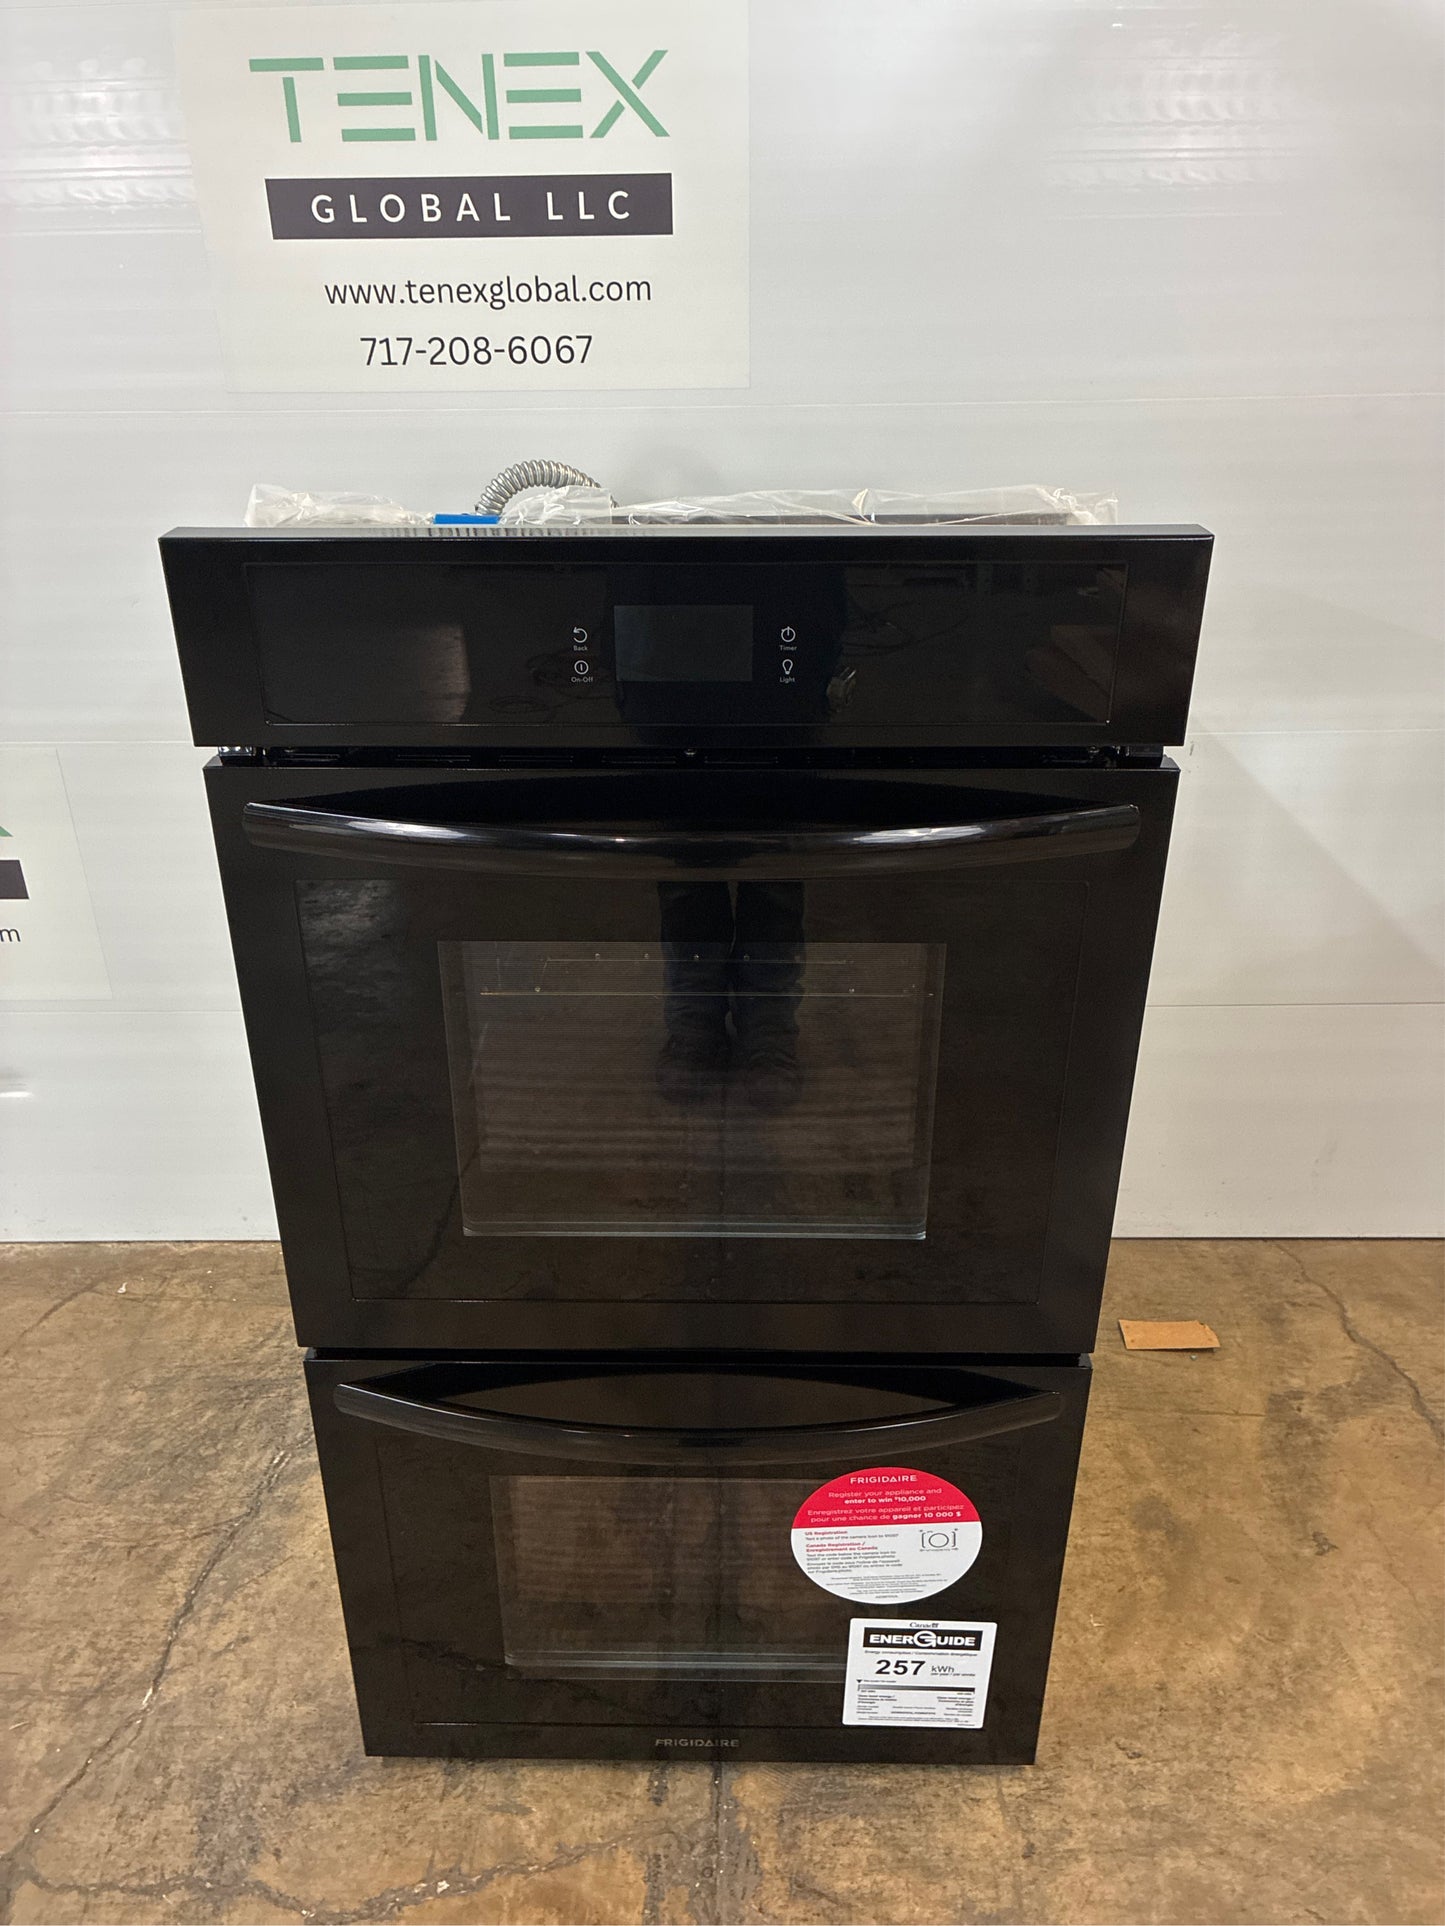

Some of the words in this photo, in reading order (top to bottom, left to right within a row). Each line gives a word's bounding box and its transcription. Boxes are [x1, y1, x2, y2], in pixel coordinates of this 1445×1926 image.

[249, 49, 670, 143] TENEX
[310, 192, 511, 224] GLOBAL
[546, 190, 630, 221] LLC
[324, 275, 652, 310] www.tenexglobal.com
[359, 335, 593, 366] 717-208-6067
[850, 1475, 918, 1485] FRIGIDAIRE
[828, 1491, 862, 1499] Register
[884, 1488, 924, 1496] appliance
[807, 1508, 852, 1516] Enregistrez
[878, 1506, 911, 1514] appareil
[923, 1504, 965, 1512] participez
[892, 1513, 921, 1521] gagner
[869, 1630, 976, 1648] ENERGUIDE
[875, 1659, 926, 1675] 257
[931, 1665, 955, 1673] kWh
[655, 1738, 740, 1747] FRIGIDAIRE
